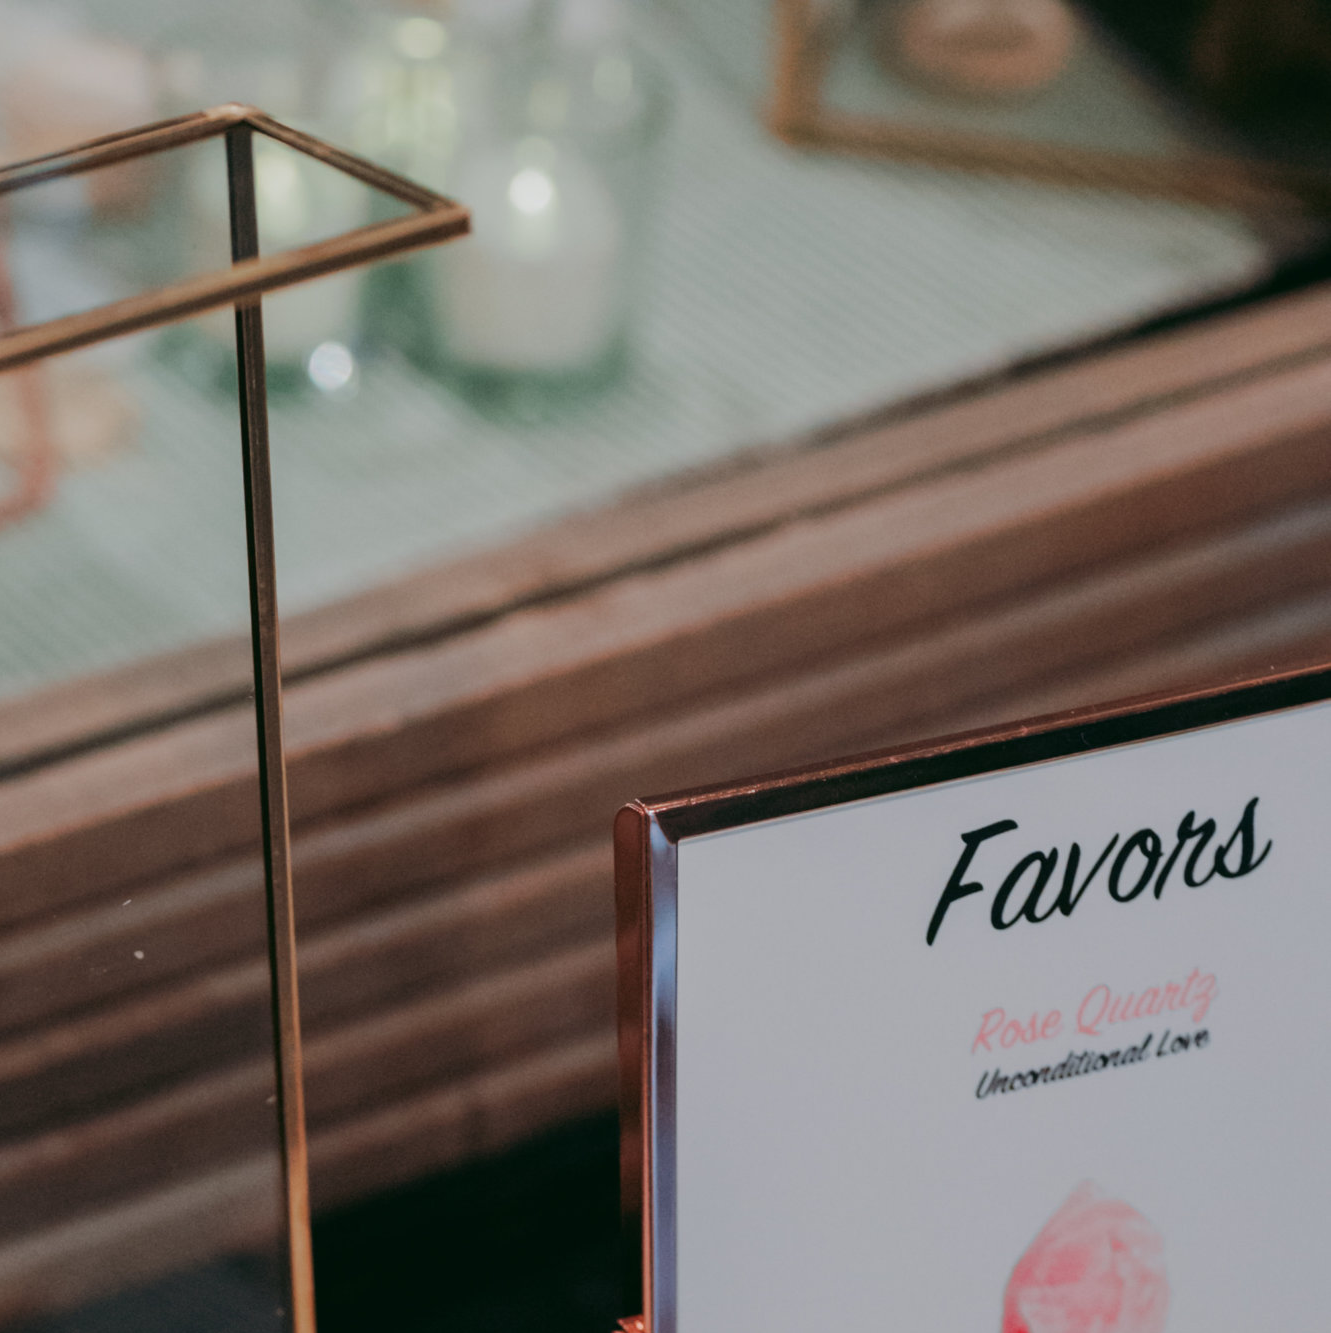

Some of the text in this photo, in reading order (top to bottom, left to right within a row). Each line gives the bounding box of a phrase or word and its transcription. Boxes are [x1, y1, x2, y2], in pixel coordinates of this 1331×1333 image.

[925, 796, 1274, 946] Favors
[971, 966, 1219, 1055] Rose Quartz
[975, 1028, 1210, 1100] Unconditional Love
